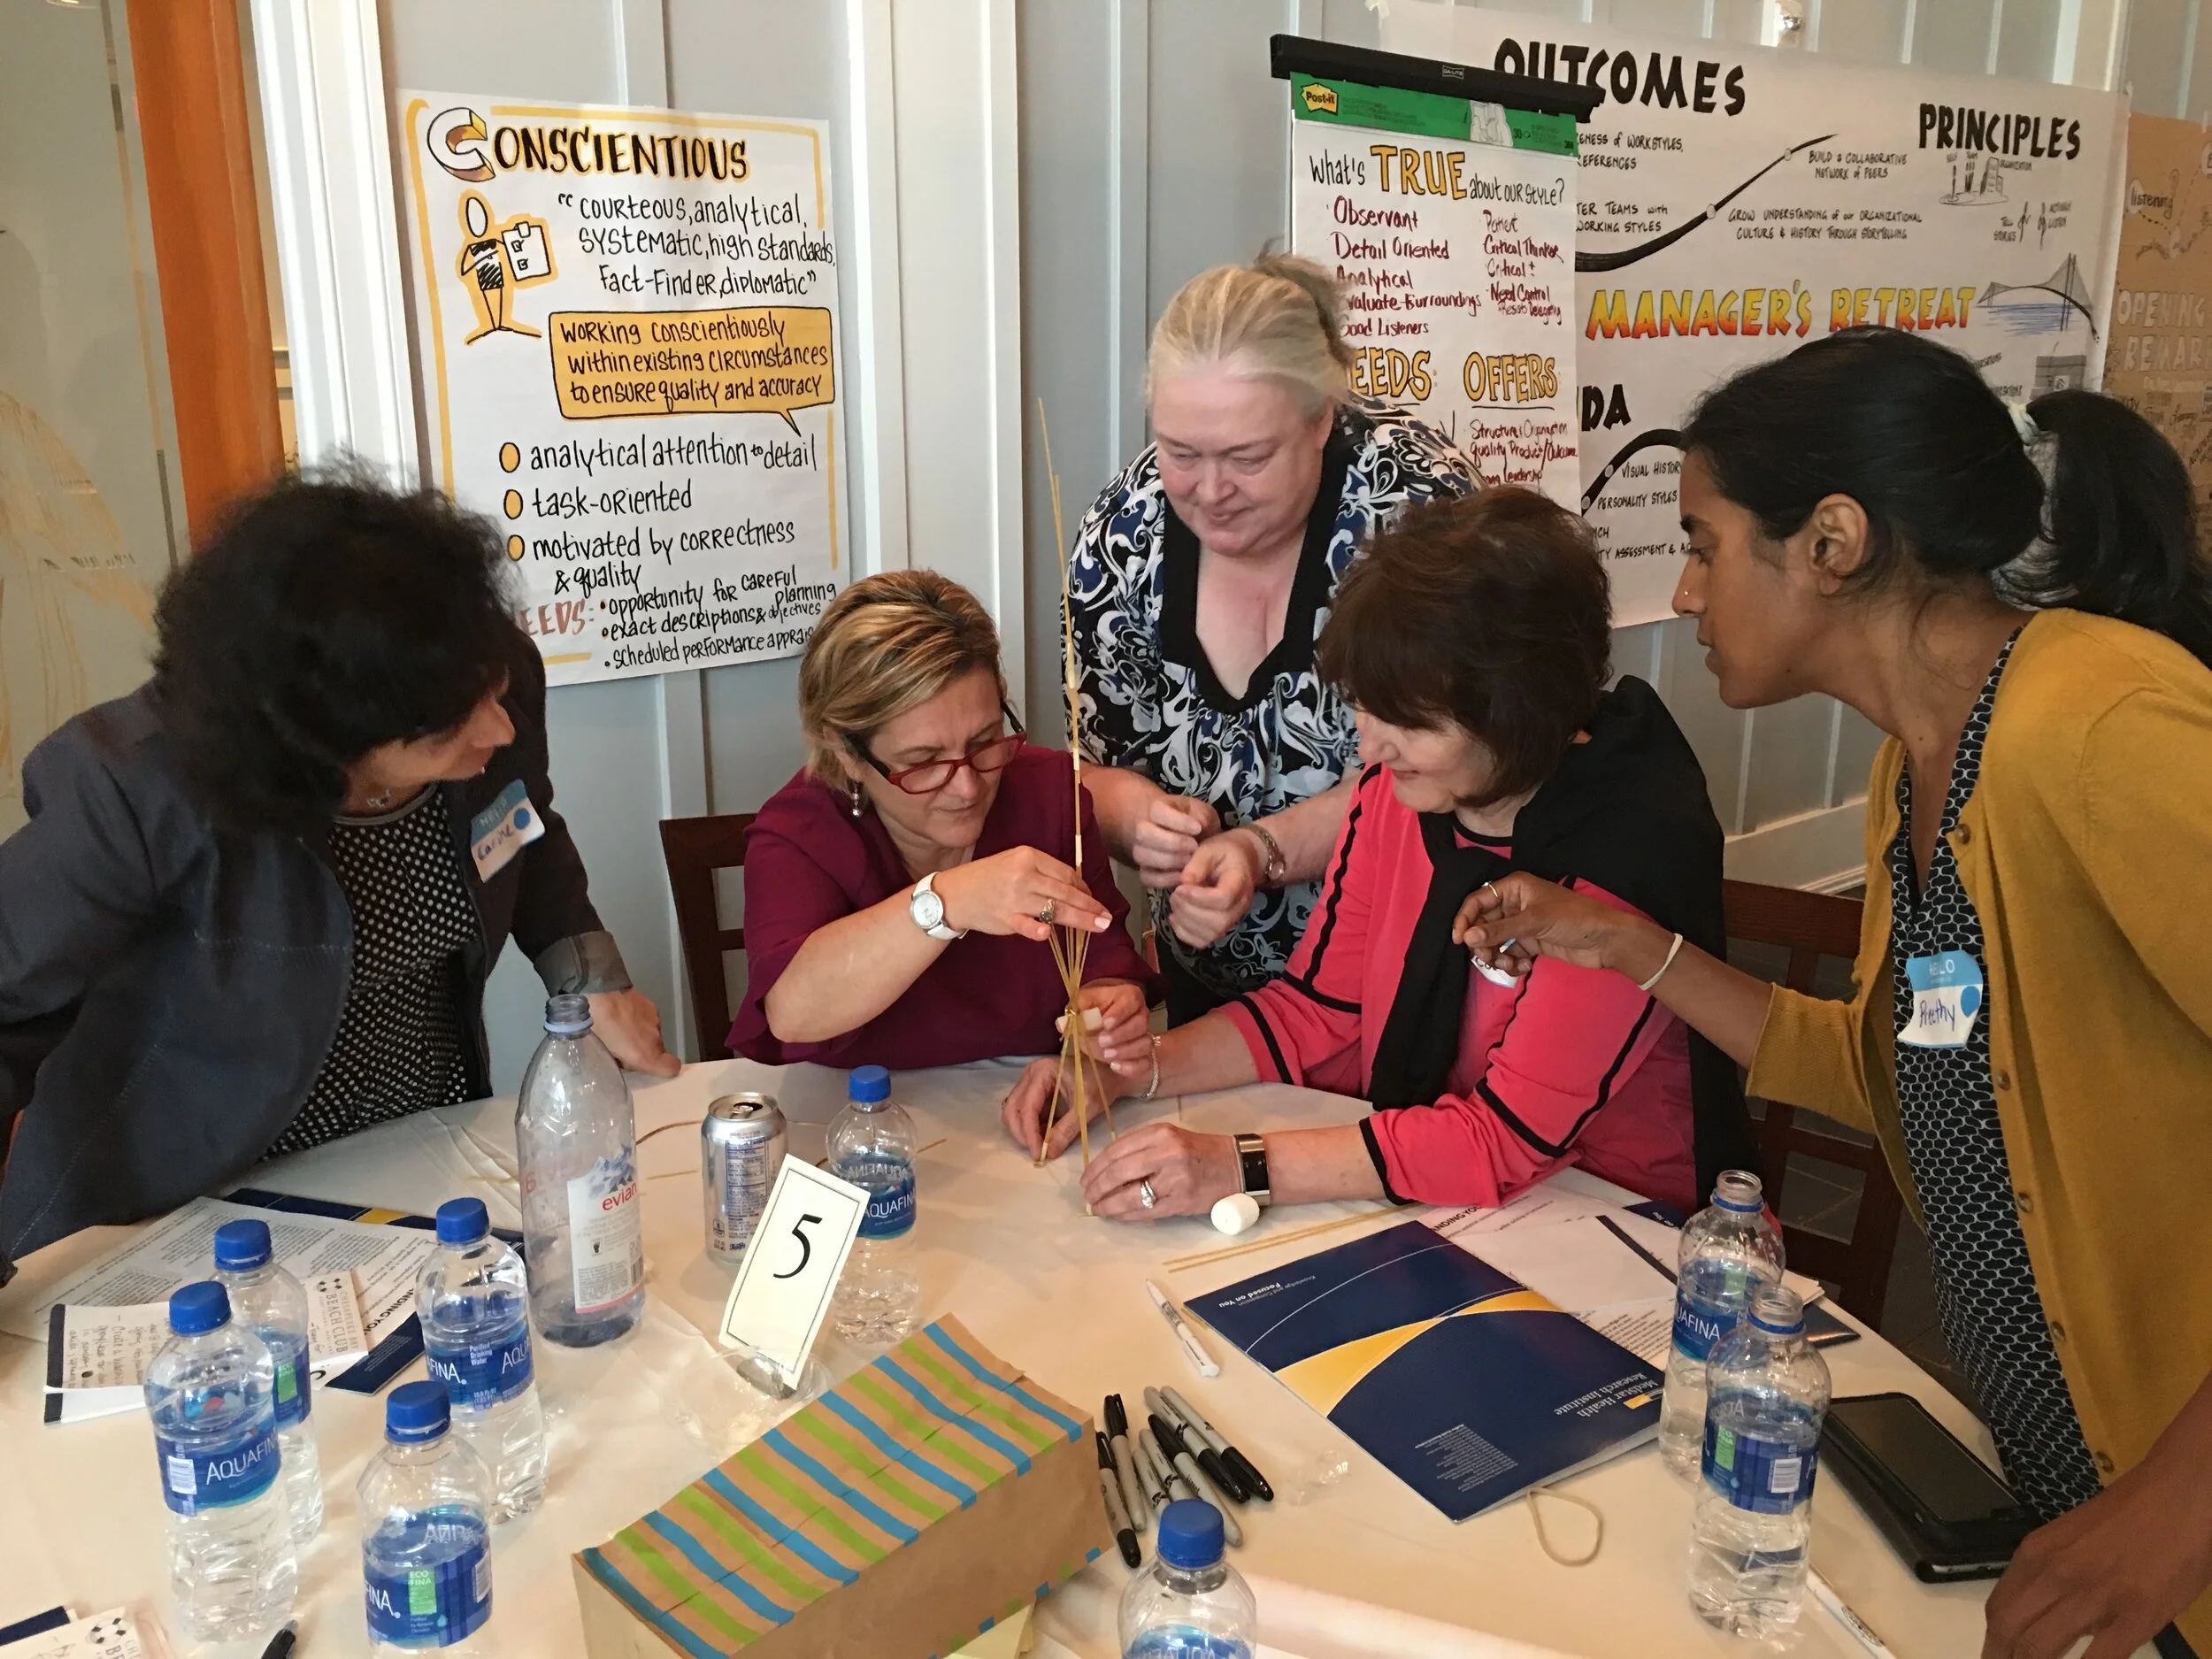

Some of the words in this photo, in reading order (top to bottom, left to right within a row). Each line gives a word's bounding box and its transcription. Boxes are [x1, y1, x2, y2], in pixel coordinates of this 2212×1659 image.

[1494, 38, 1745, 117] OUTCOMES
[1306, 91, 1336, 105] Post-it
[427, 107, 749, 182] CONSCIENTIOUS
[1918, 103, 2080, 161] PRINCIPLES
[1809, 150, 1832, 165] BUILD
[1845, 152, 1908, 165] COLLABORATIVE
[1310, 149, 1366, 187] What's
[1369, 144, 1468, 201] TRUE
[1470, 173, 1502, 201] about
[1815, 166, 1849, 180] NETWORK
[1854, 165, 1862, 180] of
[1863, 166, 1889, 180] PEERS
[1333, 195, 1418, 231] Observant
[1604, 201, 1639, 215] TEAMS
[1647, 204, 1668, 215] with
[1728, 208, 1755, 223] GROW
[1763, 207, 1828, 222] UNDERSTANDING
[1832, 209, 1840, 221] of
[1859, 211, 1923, 224] ORGANIZATIONAL
[1624, 220, 1662, 234] STYLES
[1736, 226, 1775, 240] CULTURE
[1790, 226, 1823, 240] HISTORY
[1826, 225, 1857, 240] THROUGH
[1860, 226, 1908, 241] STORYTELLING
[708, 230, 754, 260] high
[1330, 231, 1387, 259] Detail
[1392, 235, 1450, 260] Oriented
[1484, 234, 1523, 258] Critical
[1336, 264, 1414, 296] Analytical
[1490, 280, 1517, 302] Need
[1517, 283, 1551, 302] Control
[1348, 291, 1402, 312] valuate
[1584, 279, 1813, 342] MANAGER'S
[1828, 287, 1978, 333] RETREAT
[2116, 288, 2206, 327] OPENING
[650, 311, 786, 348] conscientiously
[1377, 317, 1430, 336] Listeners
[567, 349, 635, 375] within
[634, 347, 705, 373] existing
[569, 380, 593, 404] to
[657, 377, 720, 413] quality
[724, 376, 754, 401] and
[758, 374, 823, 400] accuracy
[529, 434, 646, 477] analytical
[651, 431, 749, 467] attention
[750, 443, 764, 457] to
[763, 432, 818, 472] detail
[1621, 460, 1649, 478] VISUAL
[1597, 494, 1647, 511] PERSONALITY
[1651, 489, 1678, 505] STYLES
[533, 526, 641, 562] motivated
[649, 526, 674, 566] by
[1614, 542, 1667, 560] ASSESSMENT
[1668, 543, 1676, 556] &
[554, 569, 571, 595] &
[572, 561, 642, 600] quality
[609, 583, 704, 618] opportunity
[713, 577, 738, 603] for
[775, 581, 837, 611] planning
[611, 617, 658, 641] exact
[613, 641, 681, 670] scheduled
[602, 1182, 637, 1211] evian
[772, 1213, 823, 1279] 5
[1234, 1294, 1247, 1302] on
[1247, 1281, 1281, 1299] Focused
[325, 1293, 344, 1326] BEACH
[1218, 1299, 1236, 1309] You
[331, 1326, 349, 1354] CLUB
[1599, 1372, 1648, 1394] Research
[1613, 1379, 1659, 1401] MedStar
[1553, 1390, 1602, 1416] Institute
[1576, 1396, 1617, 1417] Health
[410, 1570, 429, 1578] ECO
[411, 1578, 433, 1586] FINA
